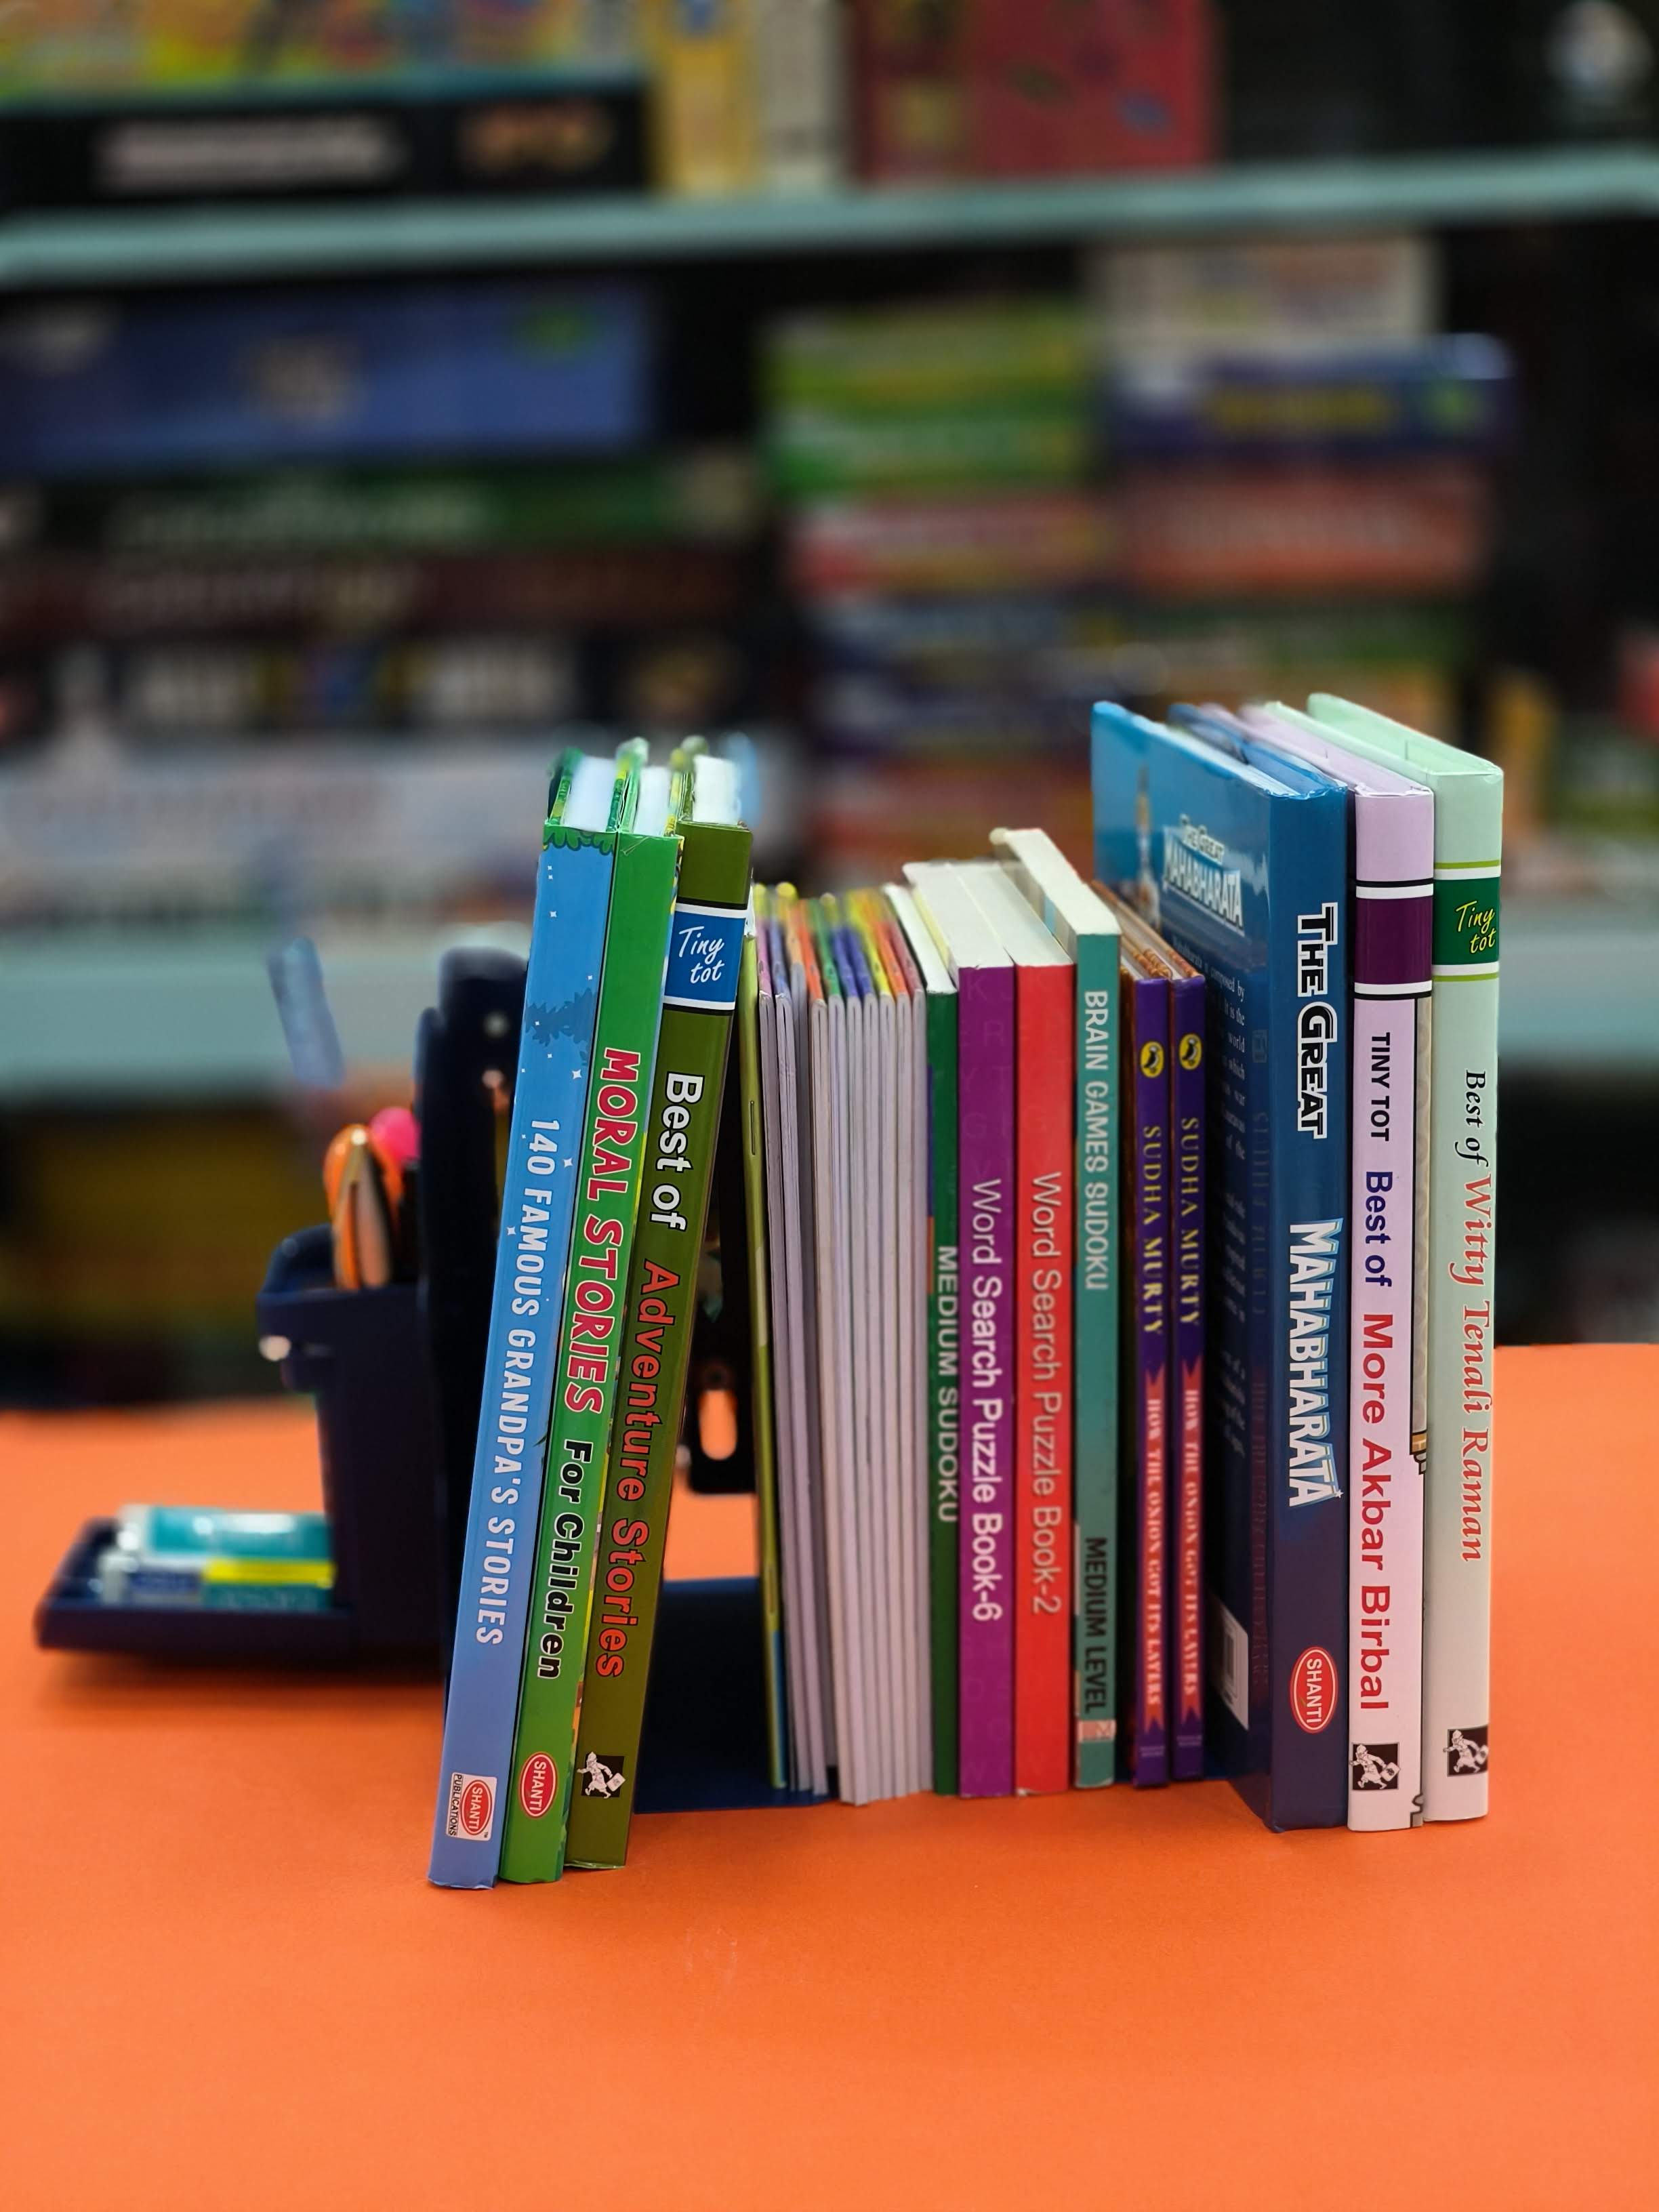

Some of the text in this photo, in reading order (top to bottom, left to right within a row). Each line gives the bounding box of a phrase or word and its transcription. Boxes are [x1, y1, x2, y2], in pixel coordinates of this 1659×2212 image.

[678, 926, 724, 965] Tiny
[691, 961, 722, 984] tot
[1237, 981, 1245, 1002] by
[1456, 901, 1495, 934] Tiny
[1469, 929, 1496, 954] tot
[1228, 1033, 1245, 1053] world
[1236, 1008, 1245, 1026] the
[1296, 903, 1338, 1139] THE GREAT
[1085, 991, 1109, 1290] BRAIN GAMES SUDOKU
[1145, 1126, 1162, 1334] SUDHA MURTY
[1181, 1118, 1198, 1326] SUDHA MURTY
[476, 1120, 560, 1644] 140 FAMOUS GRANDPA'S STORIES
[537, 1048, 640, 1679] MORAL STORIES For Children
[596, 1072, 705, 1677] Best of Adventure Stories
[937, 1245, 958, 1521] MEDIUM SUDOKU
[1289, 1218, 1343, 1509] MAHABHARATA
[1361, 1031, 1393, 1711] TINY TOT Best of More Akbar Birbal
[1450, 1069, 1492, 1563] Best of Witty Tenali Raman
[972, 1180, 1002, 1621] Word Search Puzzle Book-6
[1033, 1172, 1062, 1614] Word Search Puzzle Book-2
[1086, 1537, 1107, 1635] MEDIUM
[1086, 1644, 1106, 1714] LEVEL
[1303, 1658, 1323, 1723] SHANTI
[449, 1774, 463, 1837] PUBLICATIONS
[468, 1787, 483, 1829] SHANTI
[529, 1761, 546, 1811] SHANTI
